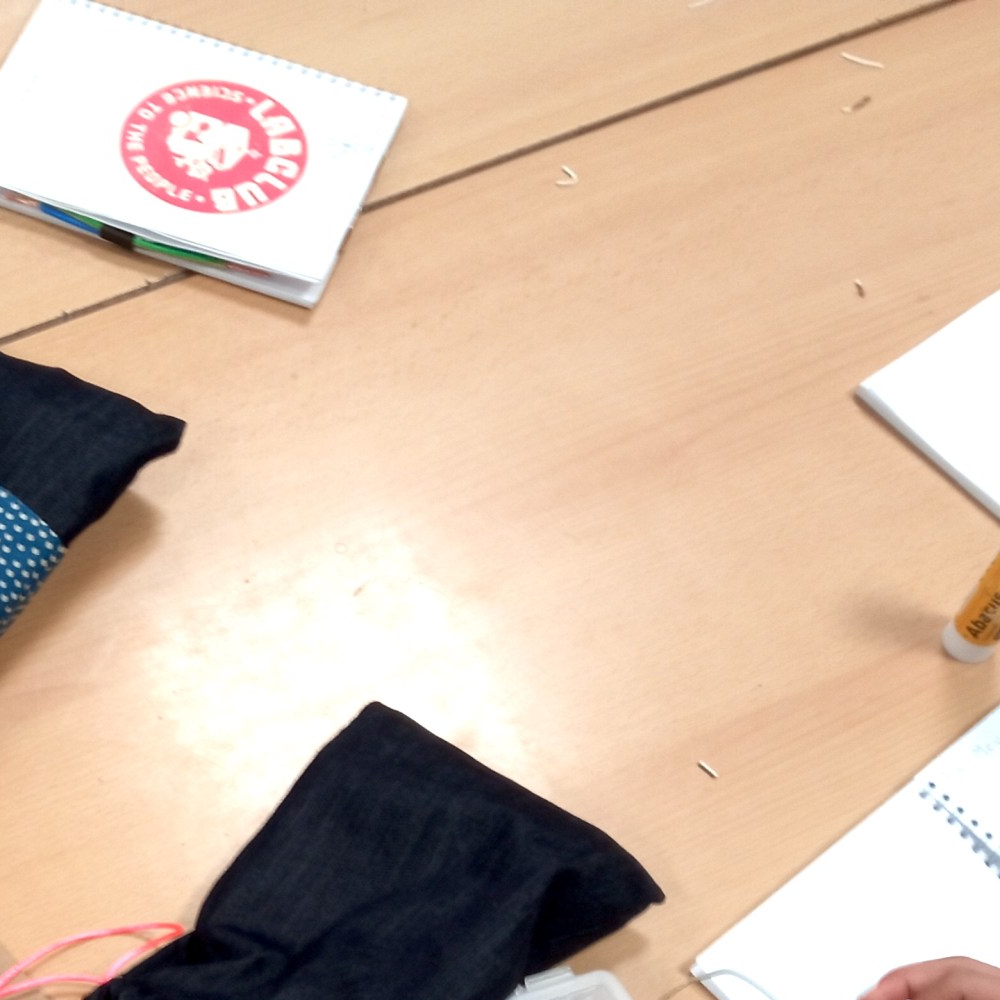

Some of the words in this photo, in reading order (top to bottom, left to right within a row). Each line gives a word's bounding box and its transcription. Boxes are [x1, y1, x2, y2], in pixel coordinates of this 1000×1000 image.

[161, 84, 246, 106] SCIENCE
[136, 101, 163, 121] TO
[125, 122, 149, 151] THE
[209, 98, 302, 212] LABCLUB
[129, 154, 194, 202] PEOPLE
